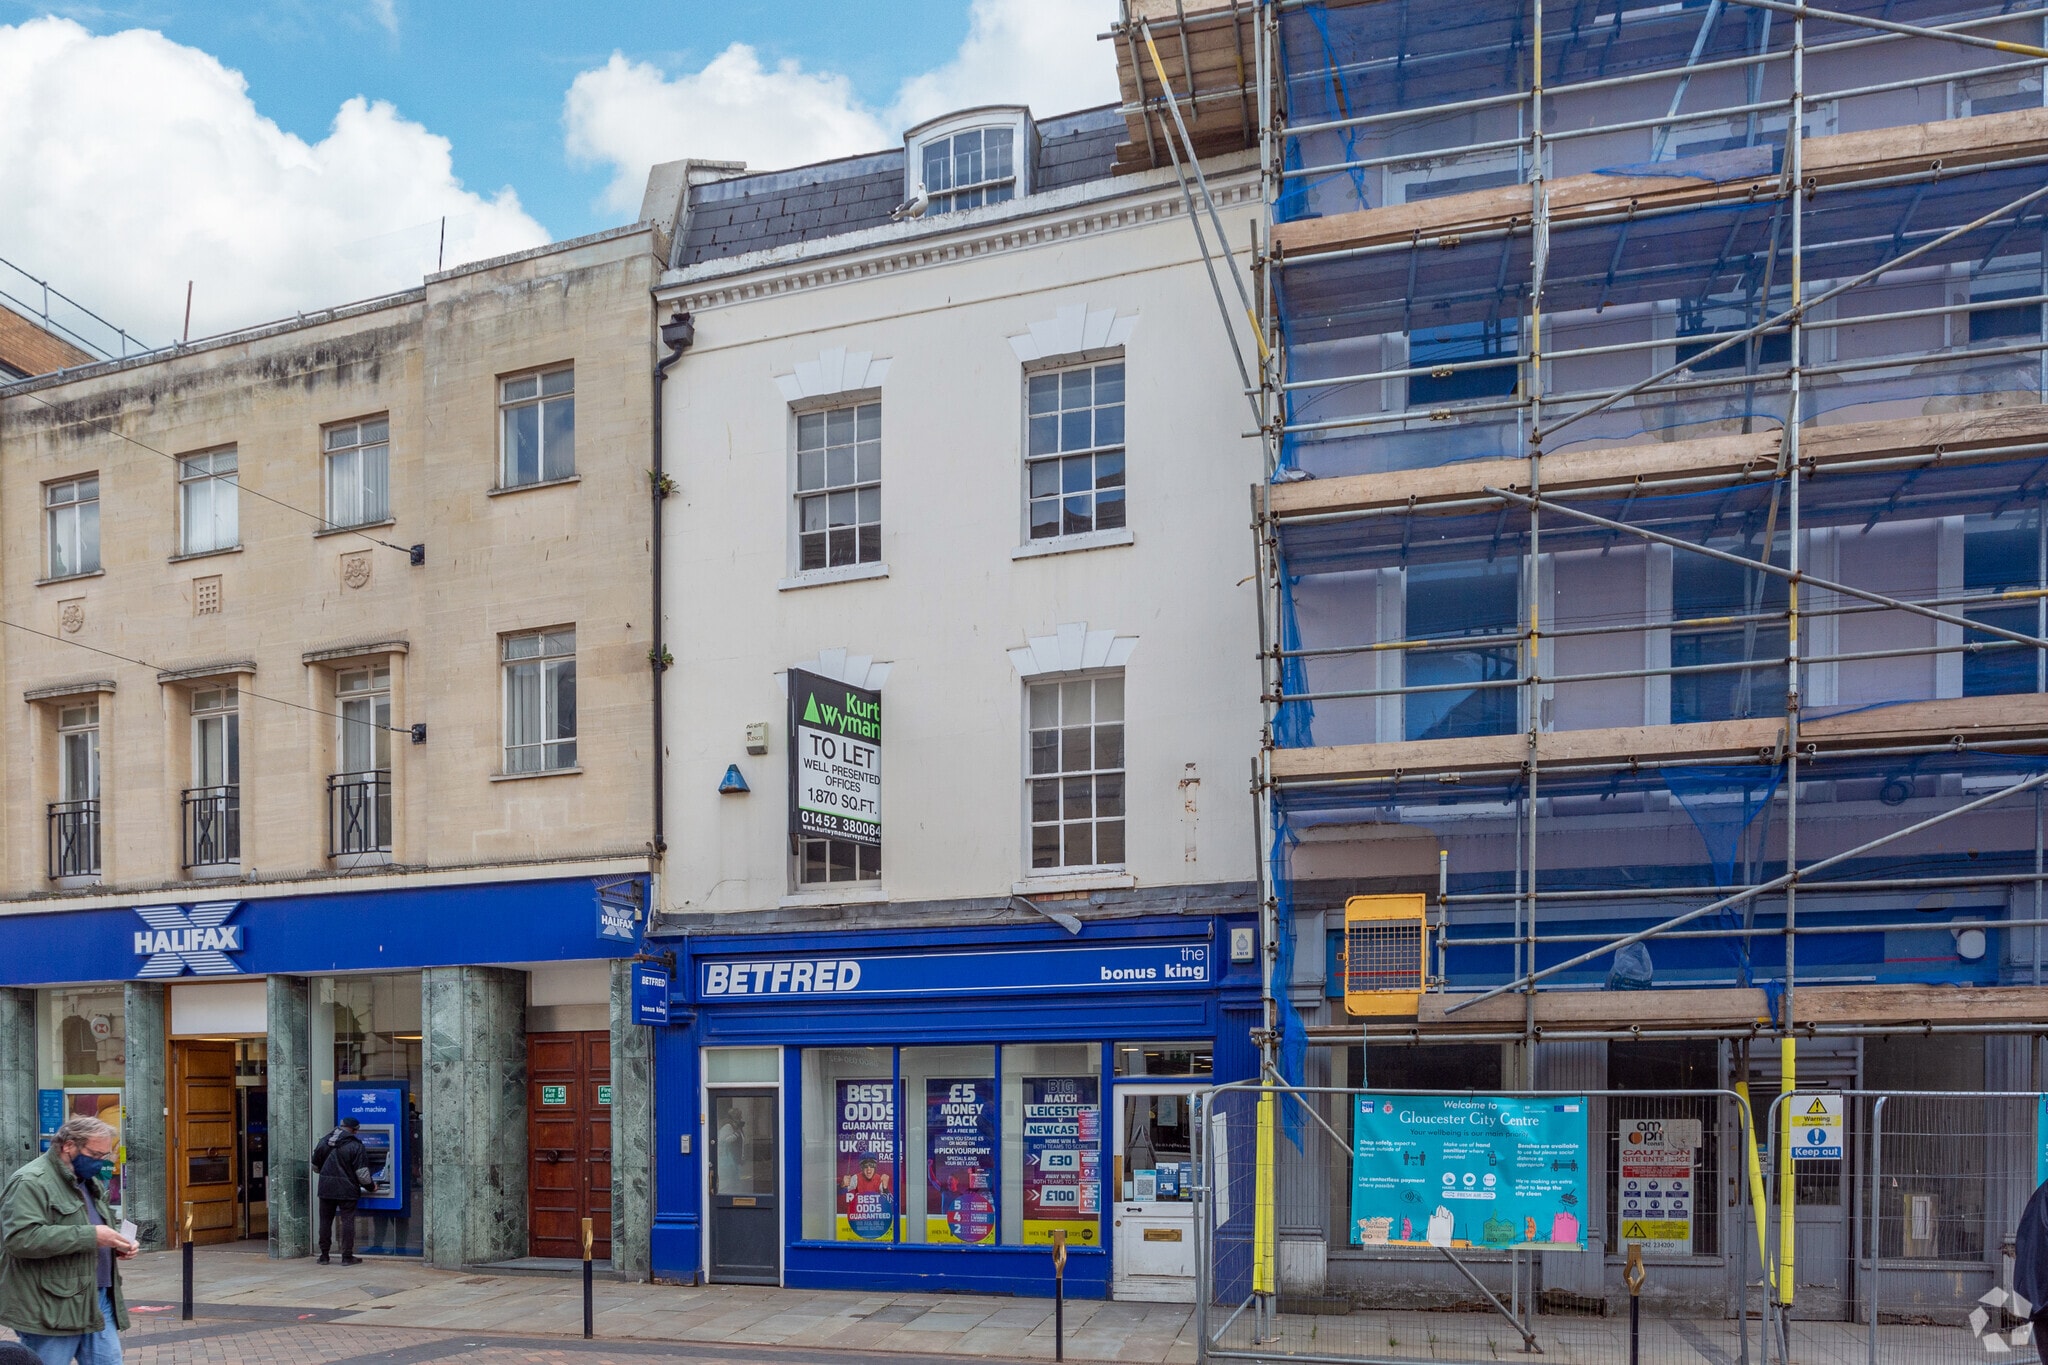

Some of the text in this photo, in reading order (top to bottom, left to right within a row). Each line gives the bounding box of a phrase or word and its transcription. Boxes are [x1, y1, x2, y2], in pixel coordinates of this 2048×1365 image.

[846, 692, 880, 722] Kurt
[820, 704, 881, 740] Wyman
[810, 734, 874, 768] TO LET
[804, 758, 880, 785] WELL PRESENTED
[826, 776, 861, 792] OFFICES
[808, 788, 877, 814] 1,870 SQ.FT.
[802, 811, 881, 836] 01452 380064
[602, 915, 634, 930] HALIFAX
[134, 926, 238, 954] HALIFAX
[1181, 947, 1204, 961] the
[706, 961, 861, 994] BETFRED
[1101, 964, 1204, 980] bonus king
[642, 976, 666, 987] BETFRED
[1048, 1080, 1074, 1093] BIG
[848, 1085, 893, 1102] BEST
[949, 1084, 976, 1102] £5
[1044, 1094, 1077, 1103] MATCH
[941, 1104, 984, 1114] MONEY
[1443, 1101, 1484, 1109] Welcome
[947, 1116, 977, 1126] BACK
[1400, 1110, 1539, 1127] Gloucester City Centre
[1030, 1126, 1079, 1134] NEWCAST
[1637, 1122, 1661, 1131] am
[1428, 1129, 1461, 1137] wellbeing
[840, 1141, 857, 1152] UK
[1796, 1148, 1819, 1156] Keep
[1049, 1156, 1072, 1166] £30
[858, 1195, 880, 1203] BEST
[1046, 1191, 1074, 1201] £100
[857, 1204, 882, 1212] ODDS
[954, 1200, 961, 1210] 5
[954, 1212, 961, 1221] 4
[954, 1224, 961, 1233] 2
